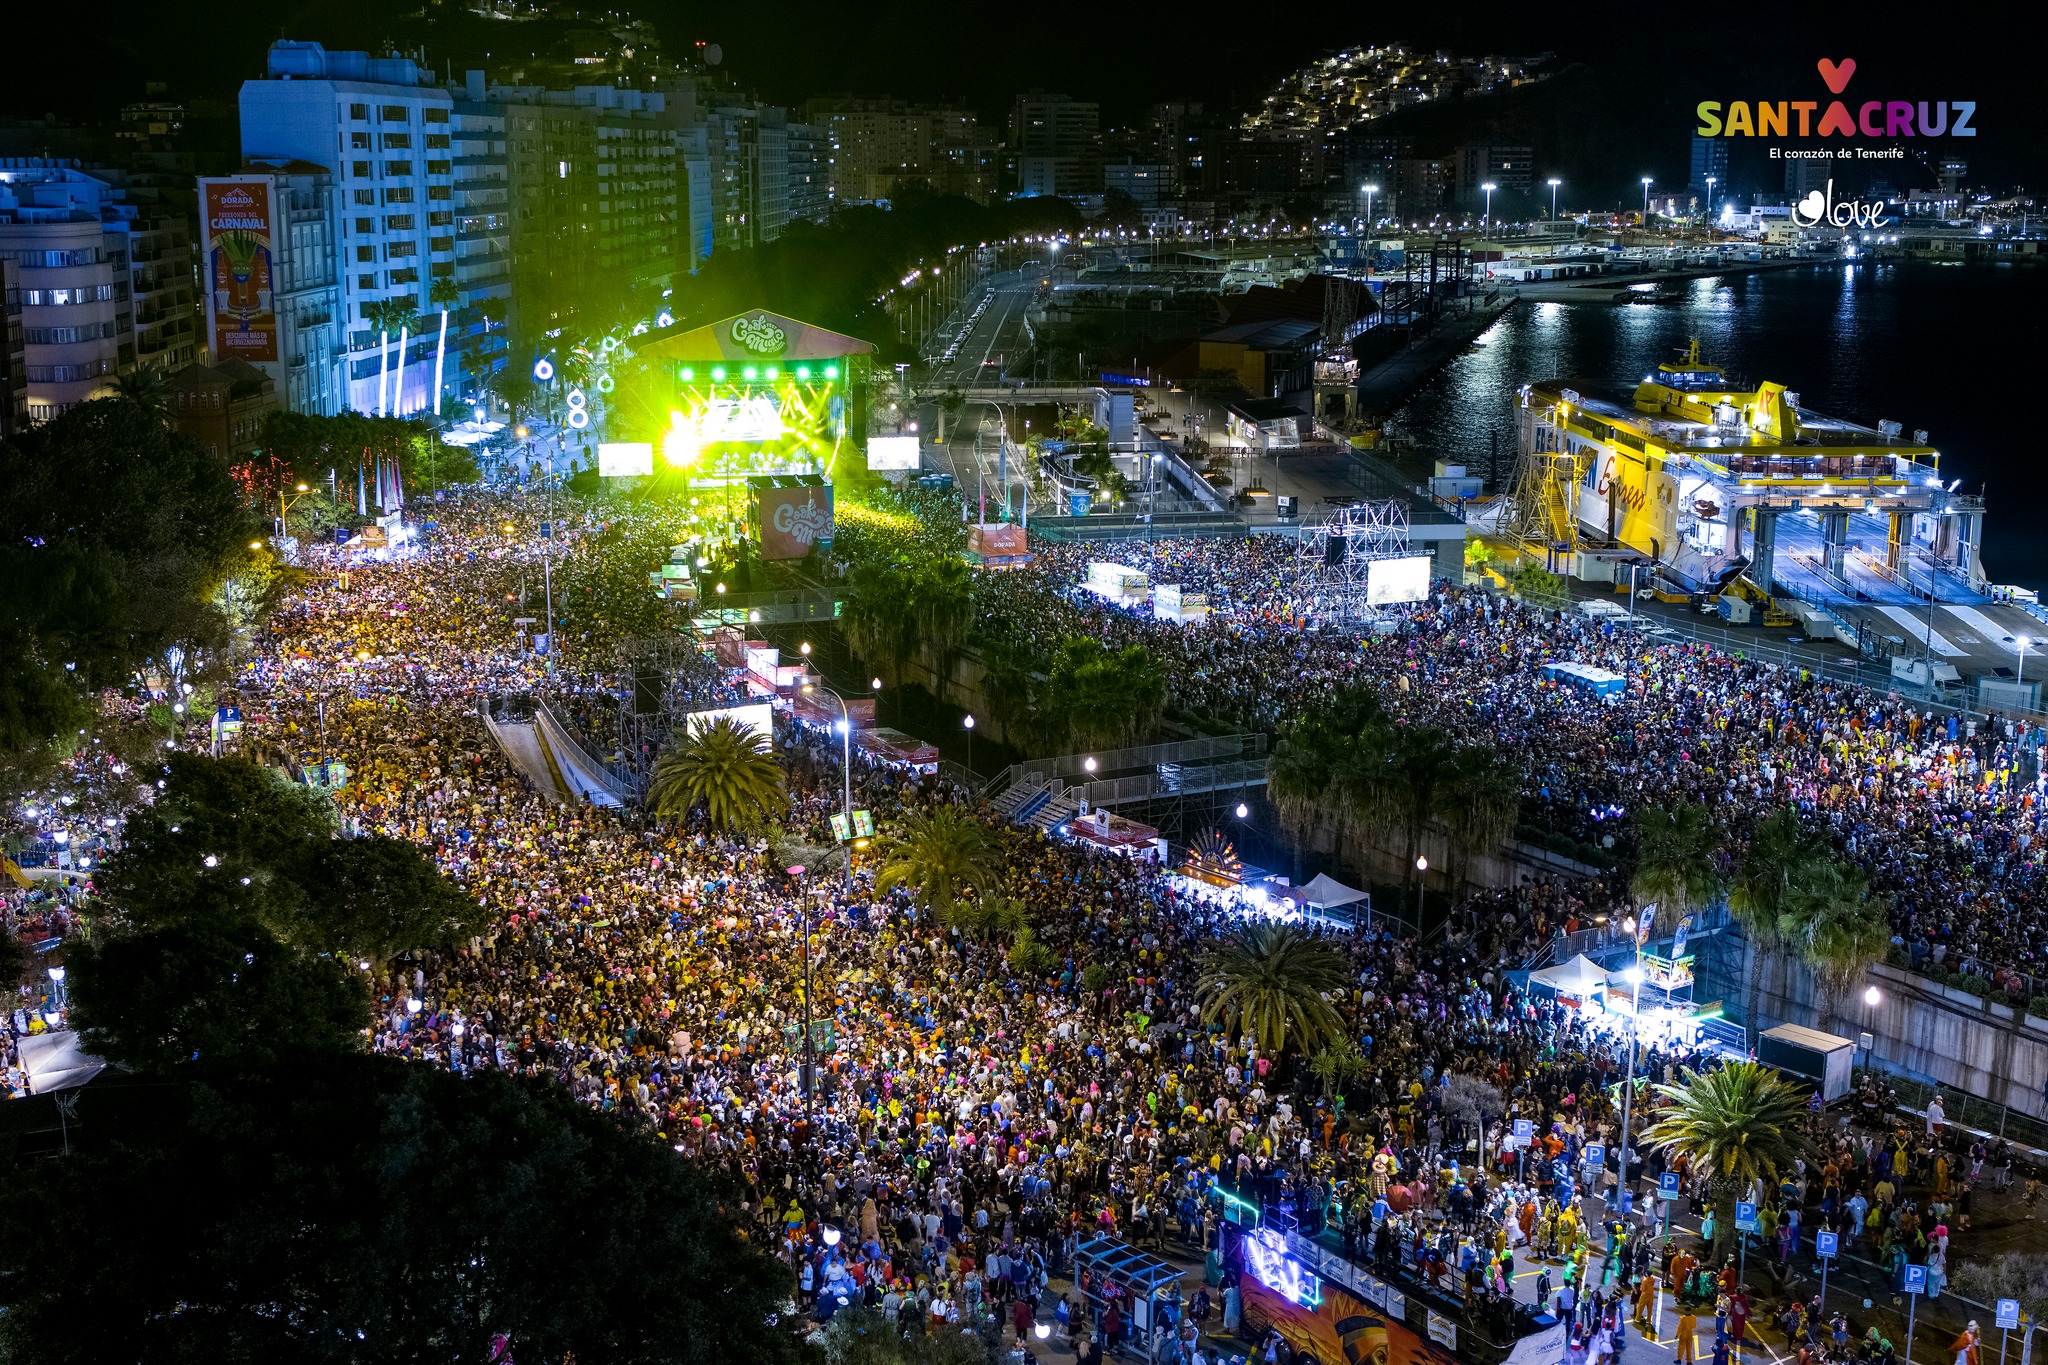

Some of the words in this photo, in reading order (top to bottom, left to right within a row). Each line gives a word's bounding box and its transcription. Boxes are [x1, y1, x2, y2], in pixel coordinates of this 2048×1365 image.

[211, 218, 267, 229] CARNAVAL
[227, 708, 234, 717] P
[1518, 1121, 1528, 1135] P
[1589, 1147, 1600, 1160] P
[1664, 1175, 1675, 1188] P
[1740, 1204, 1752, 1218] P
[1821, 1235, 1833, 1248] P
[1909, 1267, 1921, 1281] P
[2001, 1301, 2014, 1315] P
